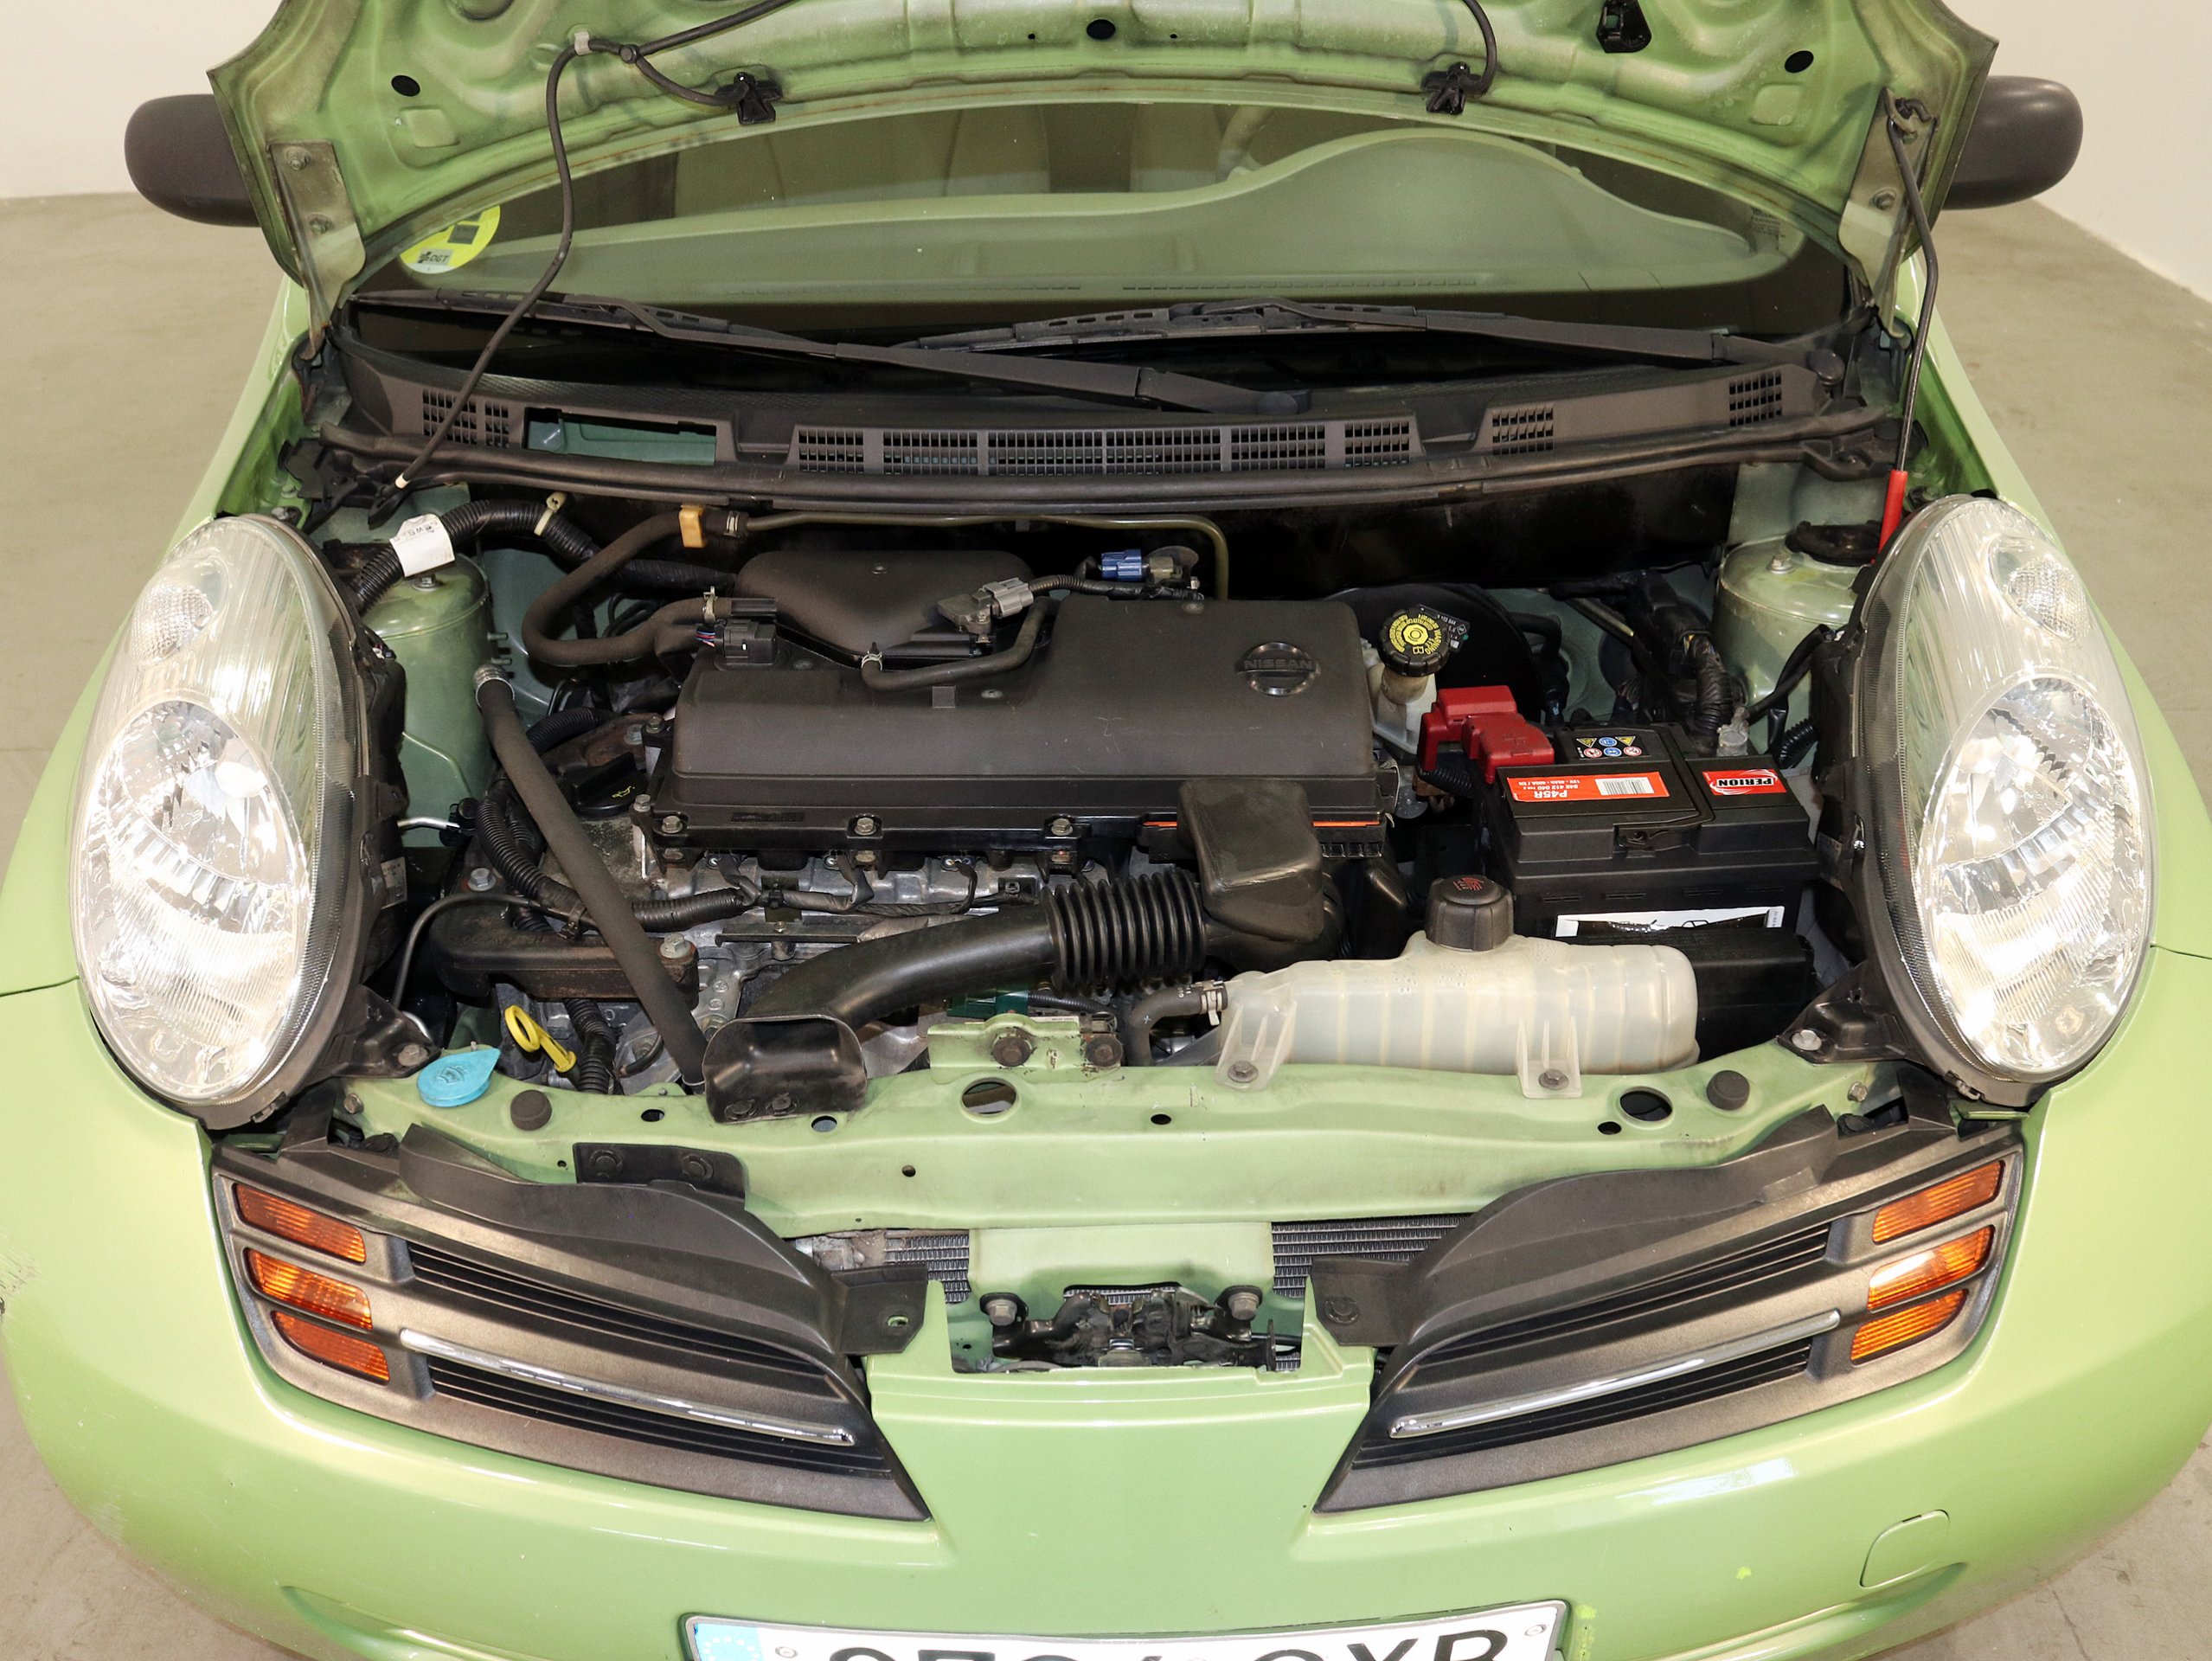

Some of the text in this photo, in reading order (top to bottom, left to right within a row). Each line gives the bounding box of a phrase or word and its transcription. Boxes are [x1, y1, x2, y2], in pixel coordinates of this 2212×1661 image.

[429, 254, 450, 263] DGT
[1425, 629, 1442, 655] WARNING
[1244, 658, 1312, 670] NISSAN
